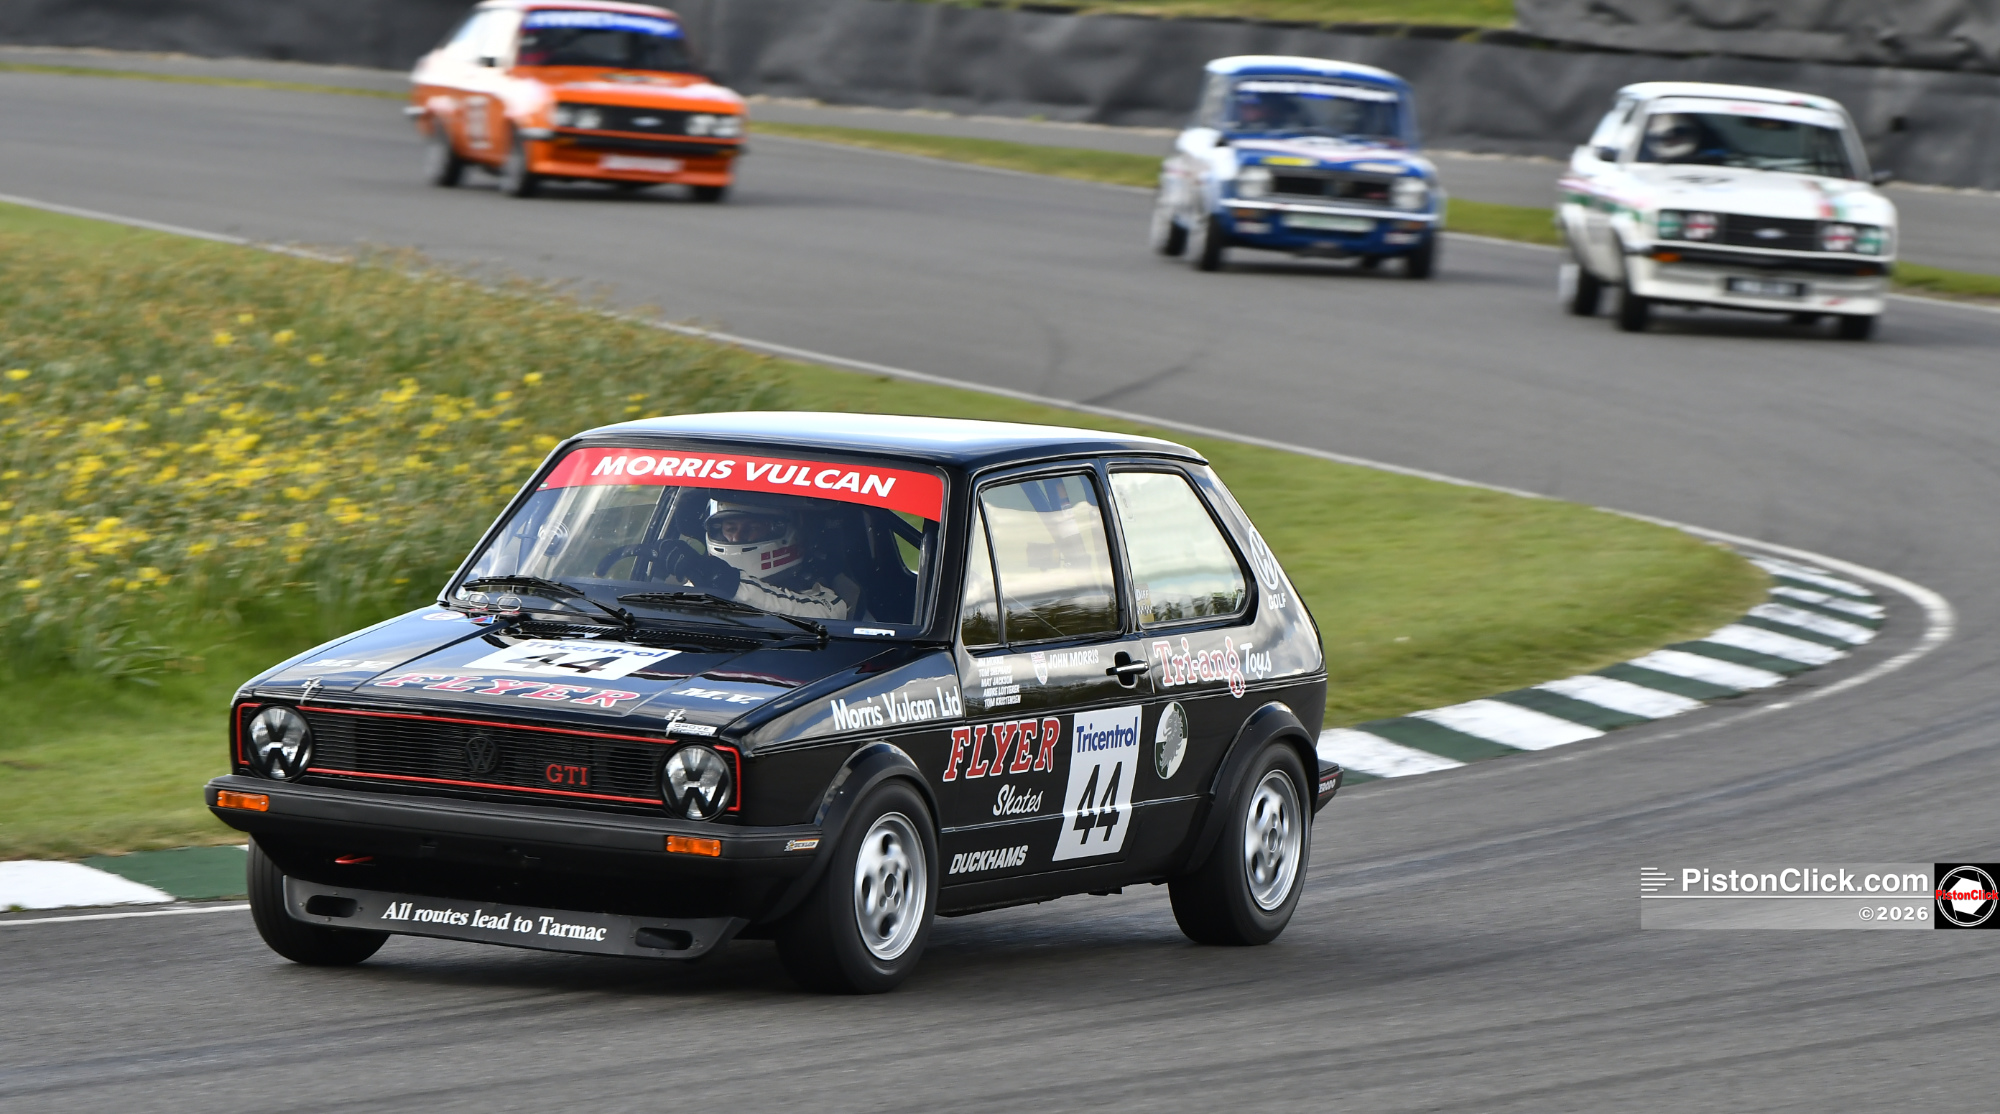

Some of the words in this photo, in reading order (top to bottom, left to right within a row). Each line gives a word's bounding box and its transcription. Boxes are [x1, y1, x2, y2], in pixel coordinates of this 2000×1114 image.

[591, 456, 736, 479] MORRIS
[745, 463, 896, 497] VULCAN
[1268, 592, 1287, 610] GOLF
[503, 652, 622, 673] 44
[525, 641, 669, 658] Tricentrol
[1048, 654, 1069, 669] JOHN
[1070, 649, 1099, 666] MORRIS
[981, 678, 992, 687] MAT
[993, 675, 1013, 685] JACKSON
[1152, 636, 1246, 698] Tri-ang
[1240, 642, 1272, 680] Toys
[374, 673, 640, 708] FLYER
[830, 698, 884, 731] Morris
[884, 692, 937, 723] Vulcan
[937, 686, 963, 717] Ltd
[943, 716, 1061, 783] FLYER
[1076, 716, 1139, 753] Tricentrol
[546, 763, 588, 786] GTI
[1318, 778, 1336, 794] ERODO
[993, 784, 1044, 816] Skates
[1073, 761, 1123, 845] 44
[949, 845, 1029, 875] DUCKHAMS
[381, 901, 412, 921] All
[413, 907, 469, 926] routes
[470, 908, 512, 931] lead
[513, 915, 533, 934] to
[538, 915, 607, 943] Tarmac
